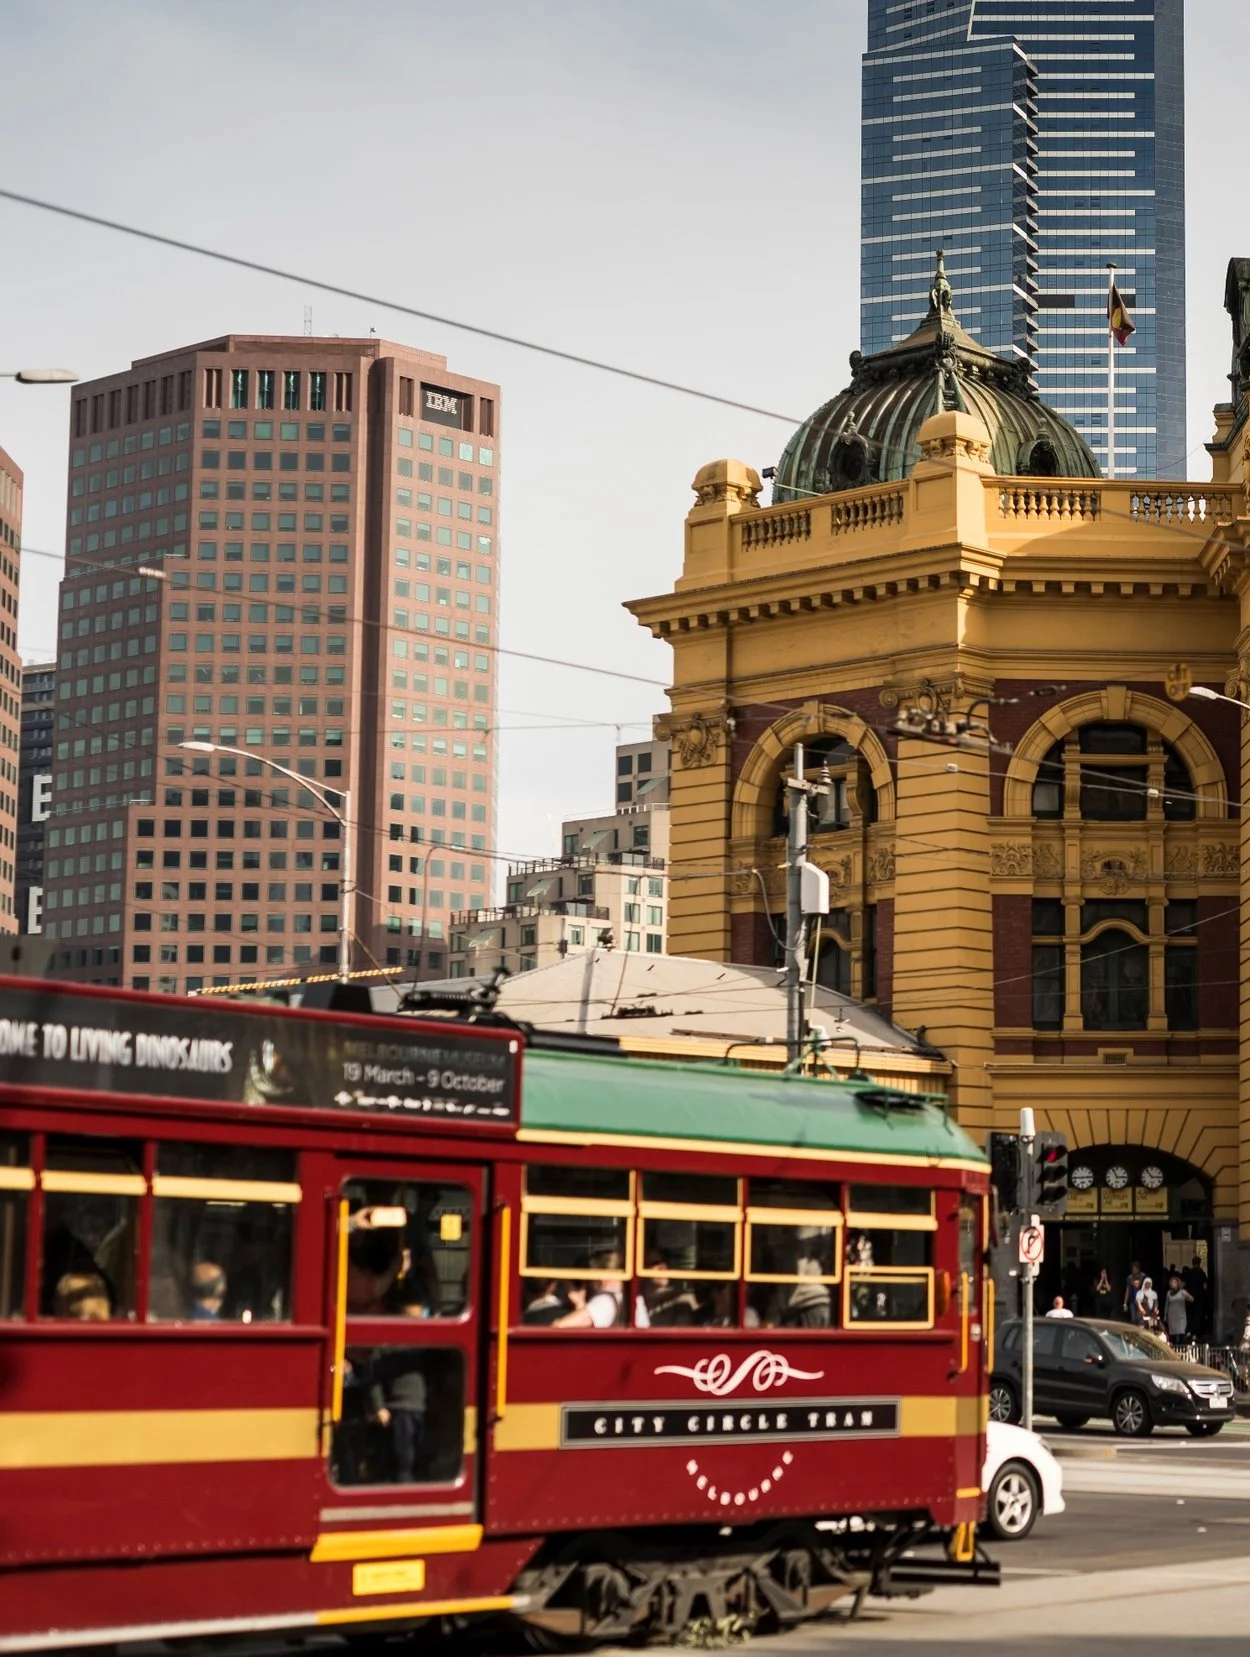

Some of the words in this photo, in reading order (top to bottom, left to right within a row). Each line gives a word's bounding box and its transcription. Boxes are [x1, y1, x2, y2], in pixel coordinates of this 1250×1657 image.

[426, 391, 457, 414] IBM
[42, 1024, 67, 1060] TO
[70, 1026, 132, 1066] LIVING
[135, 1033, 233, 1073] DINOSAURS
[343, 1062, 362, 1082] 19
[364, 1064, 415, 1086] March
[427, 1069, 440, 1089] 9
[441, 1071, 505, 1093] October
[594, 1416, 665, 1435] CITY
[687, 1413, 788, 1432] CIRCLE
